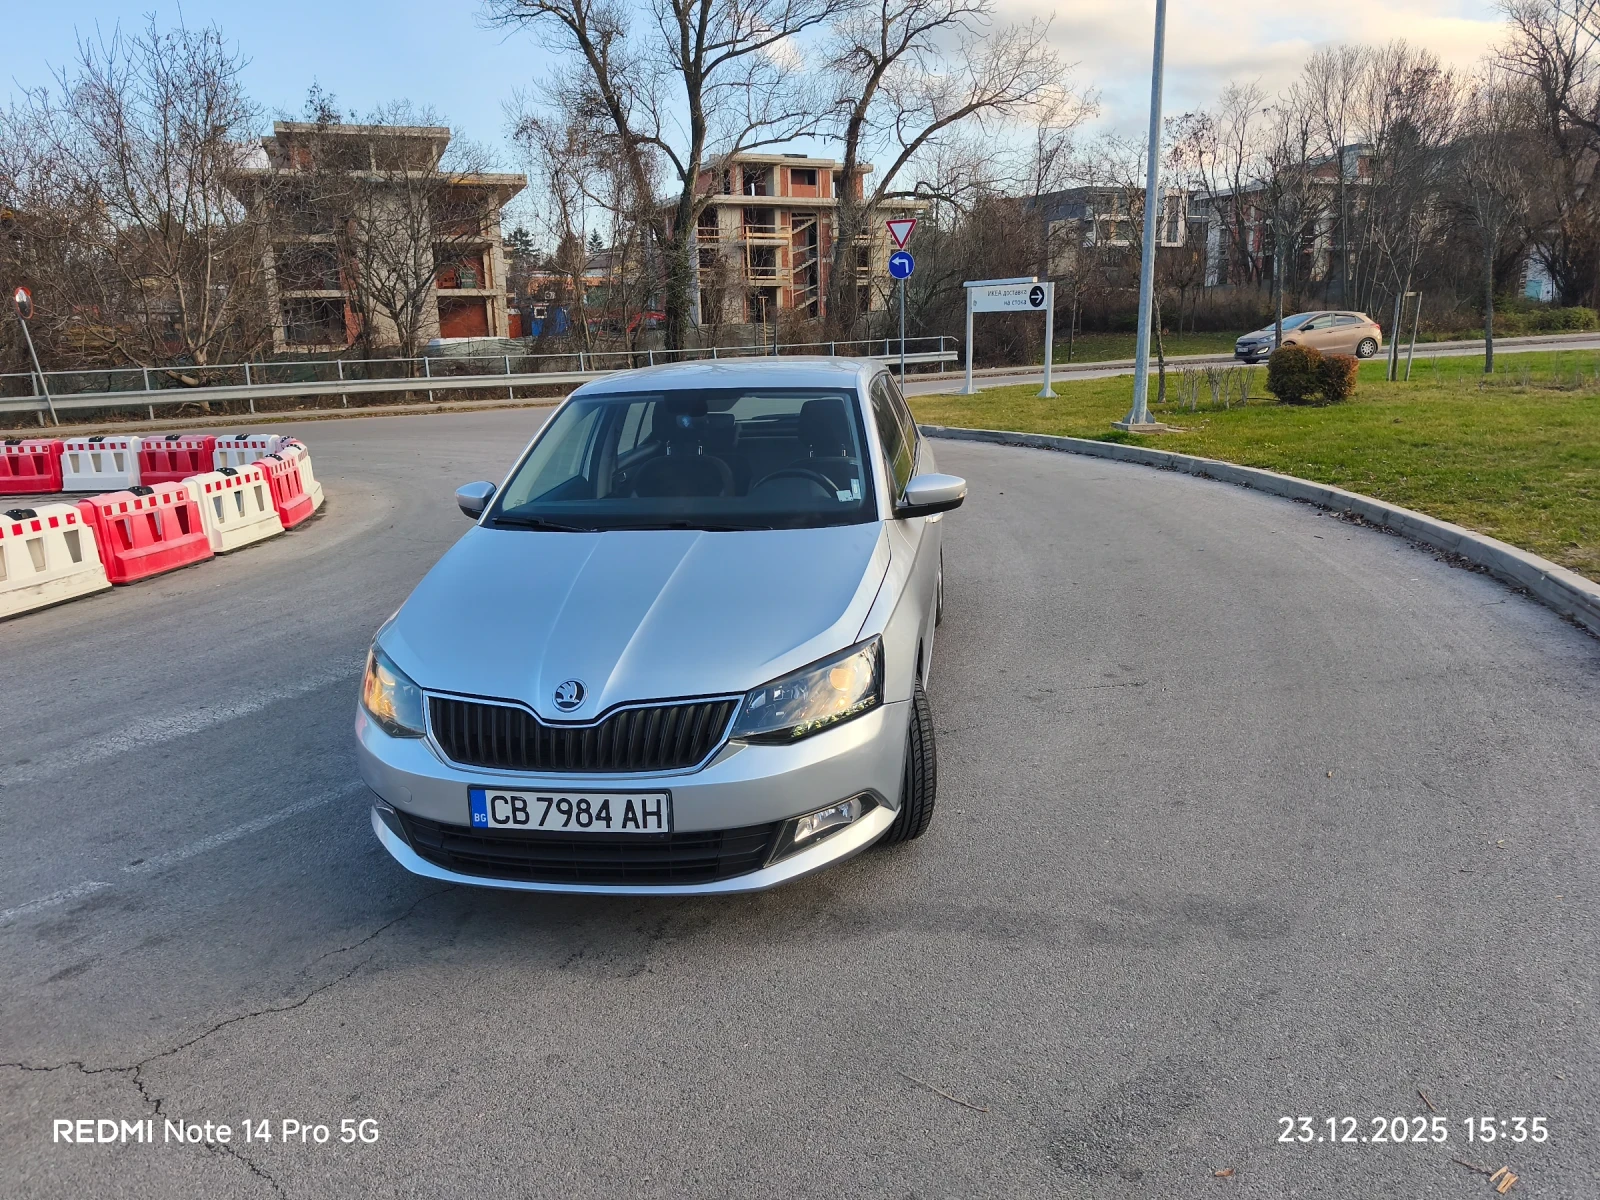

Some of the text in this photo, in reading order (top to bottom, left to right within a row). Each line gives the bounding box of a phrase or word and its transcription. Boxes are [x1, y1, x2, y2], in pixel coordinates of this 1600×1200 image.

[474, 812, 487, 823] BG
[490, 795, 663, 829] CB 7984 AH
